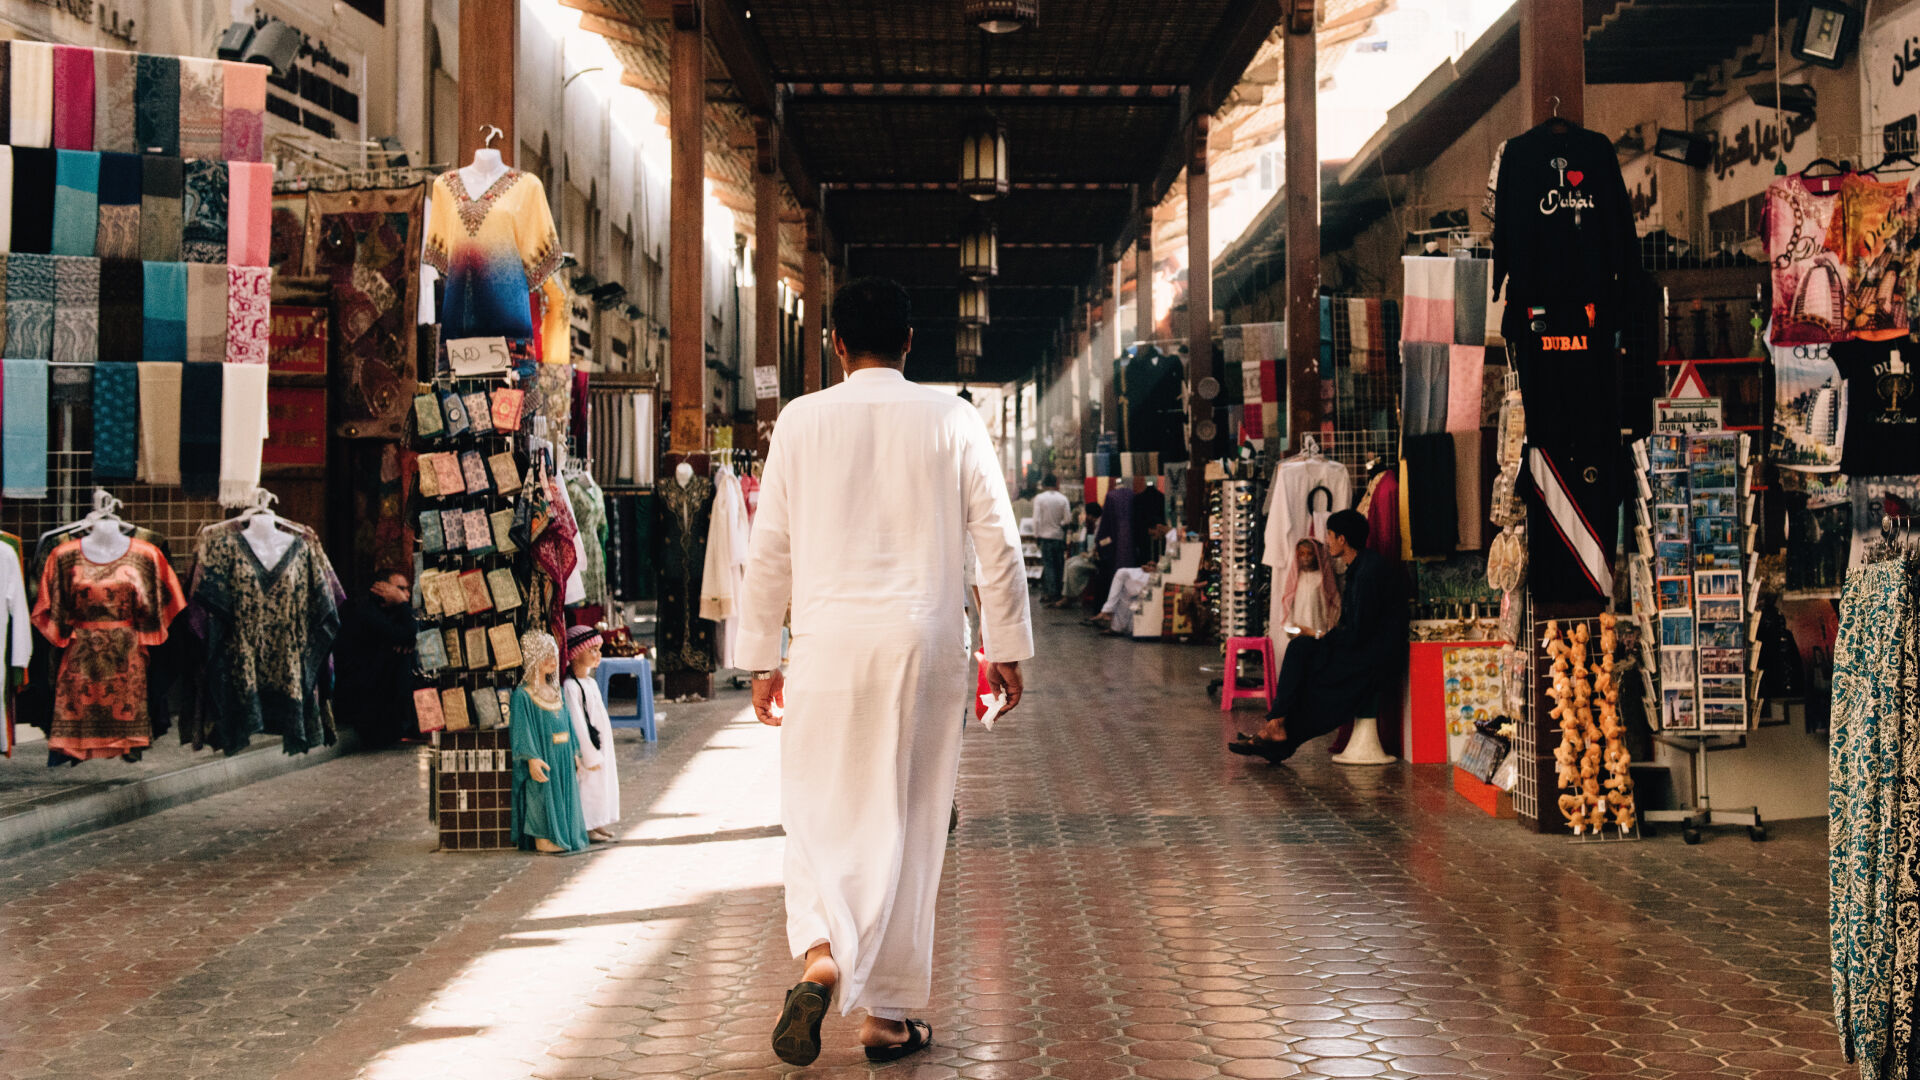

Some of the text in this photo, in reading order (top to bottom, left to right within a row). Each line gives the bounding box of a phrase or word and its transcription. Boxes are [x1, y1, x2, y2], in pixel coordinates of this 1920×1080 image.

[1539, 189, 1595, 215] Dubai
[1541, 335, 1588, 351] DUBAI
[450, 344, 507, 369] AED 5
